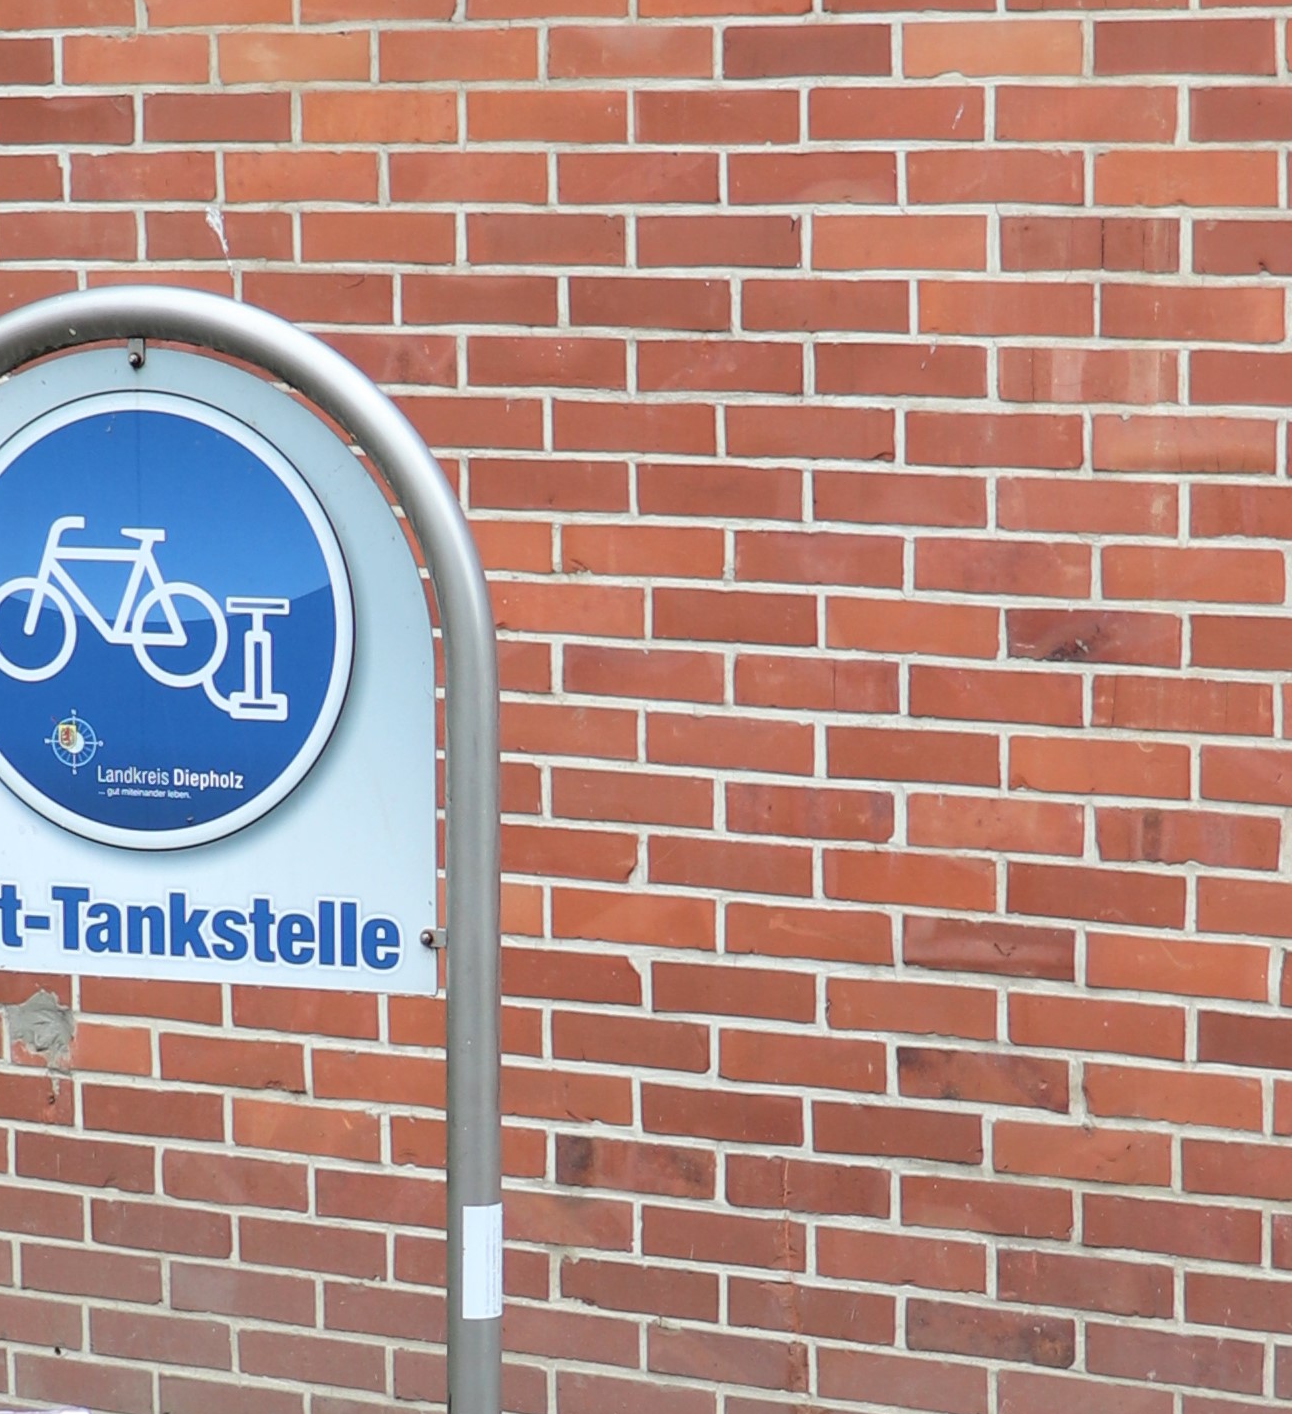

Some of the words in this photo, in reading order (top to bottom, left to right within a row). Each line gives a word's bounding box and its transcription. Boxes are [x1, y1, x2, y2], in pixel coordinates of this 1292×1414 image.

[97, 764, 170, 786] Landkreis
[173, 768, 244, 791] Diepholz
[107, 788, 120, 798] gut
[121, 788, 166, 798] miteinander
